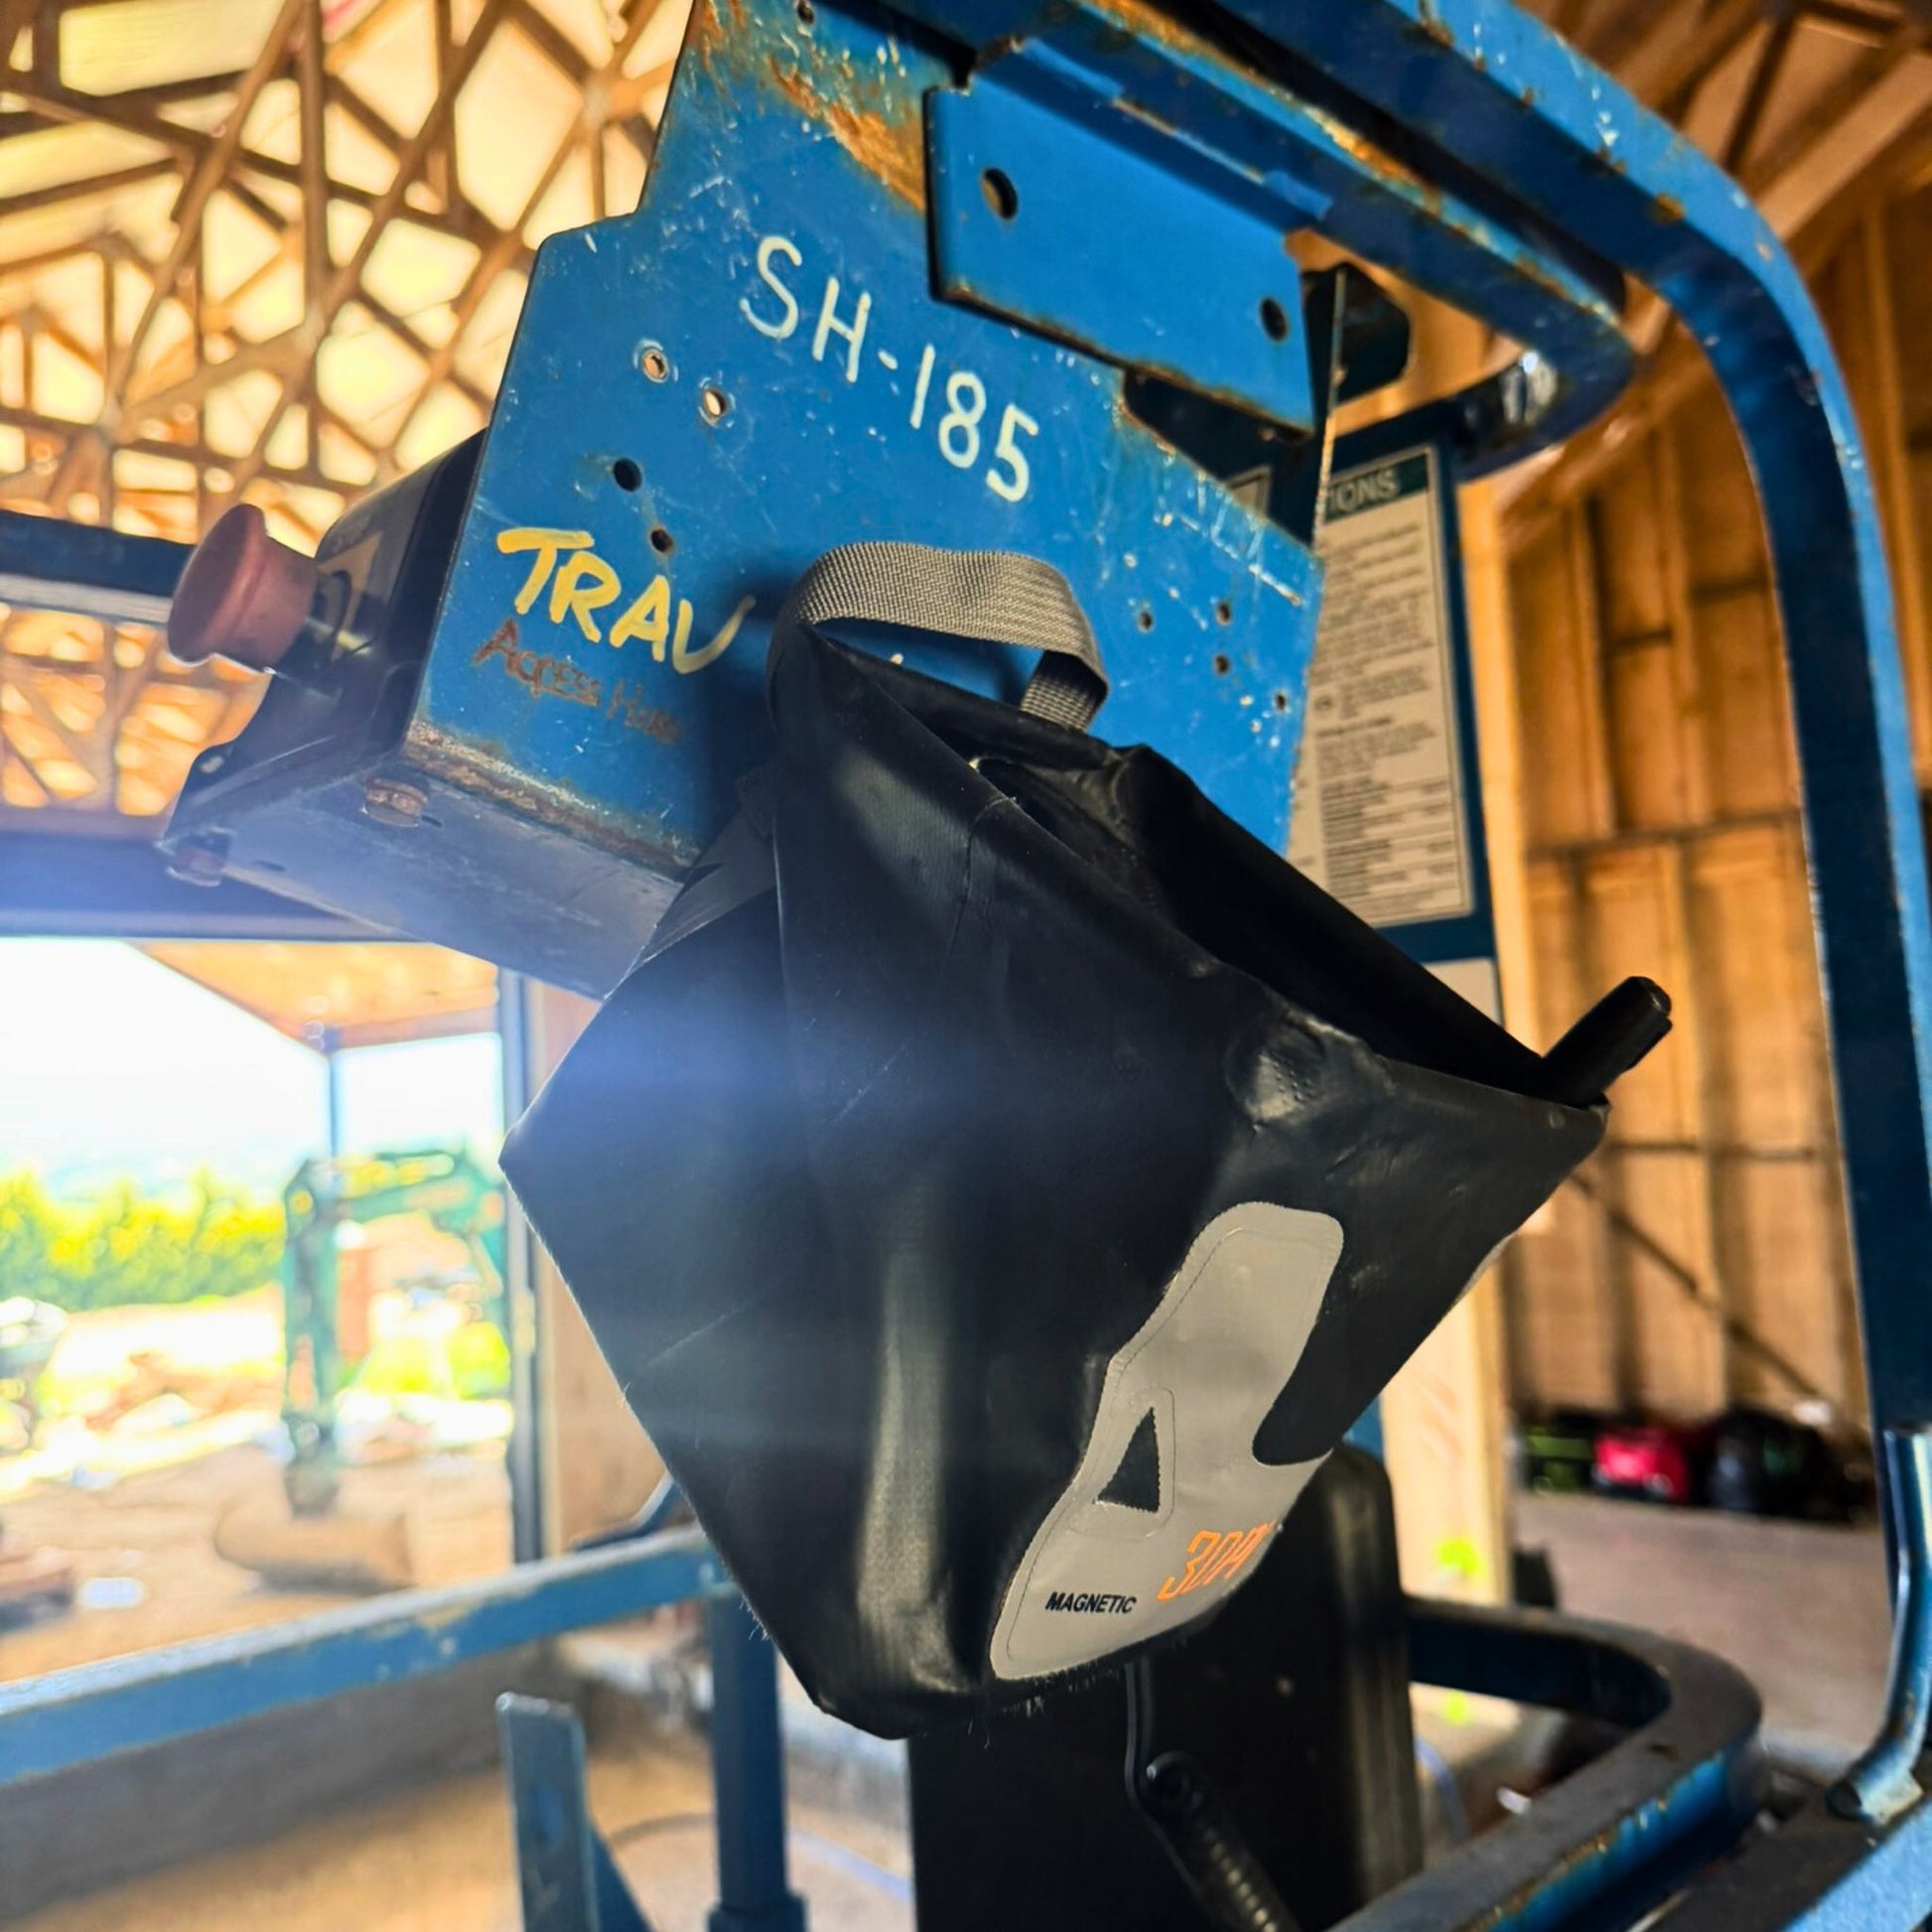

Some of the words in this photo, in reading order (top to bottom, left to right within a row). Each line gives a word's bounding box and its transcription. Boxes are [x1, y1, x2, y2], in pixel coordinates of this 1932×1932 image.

[740, 235, 1039, 502] SH-185
[1327, 469, 1400, 513] IONS
[1045, 1591, 1138, 1614] MAGNETIC
